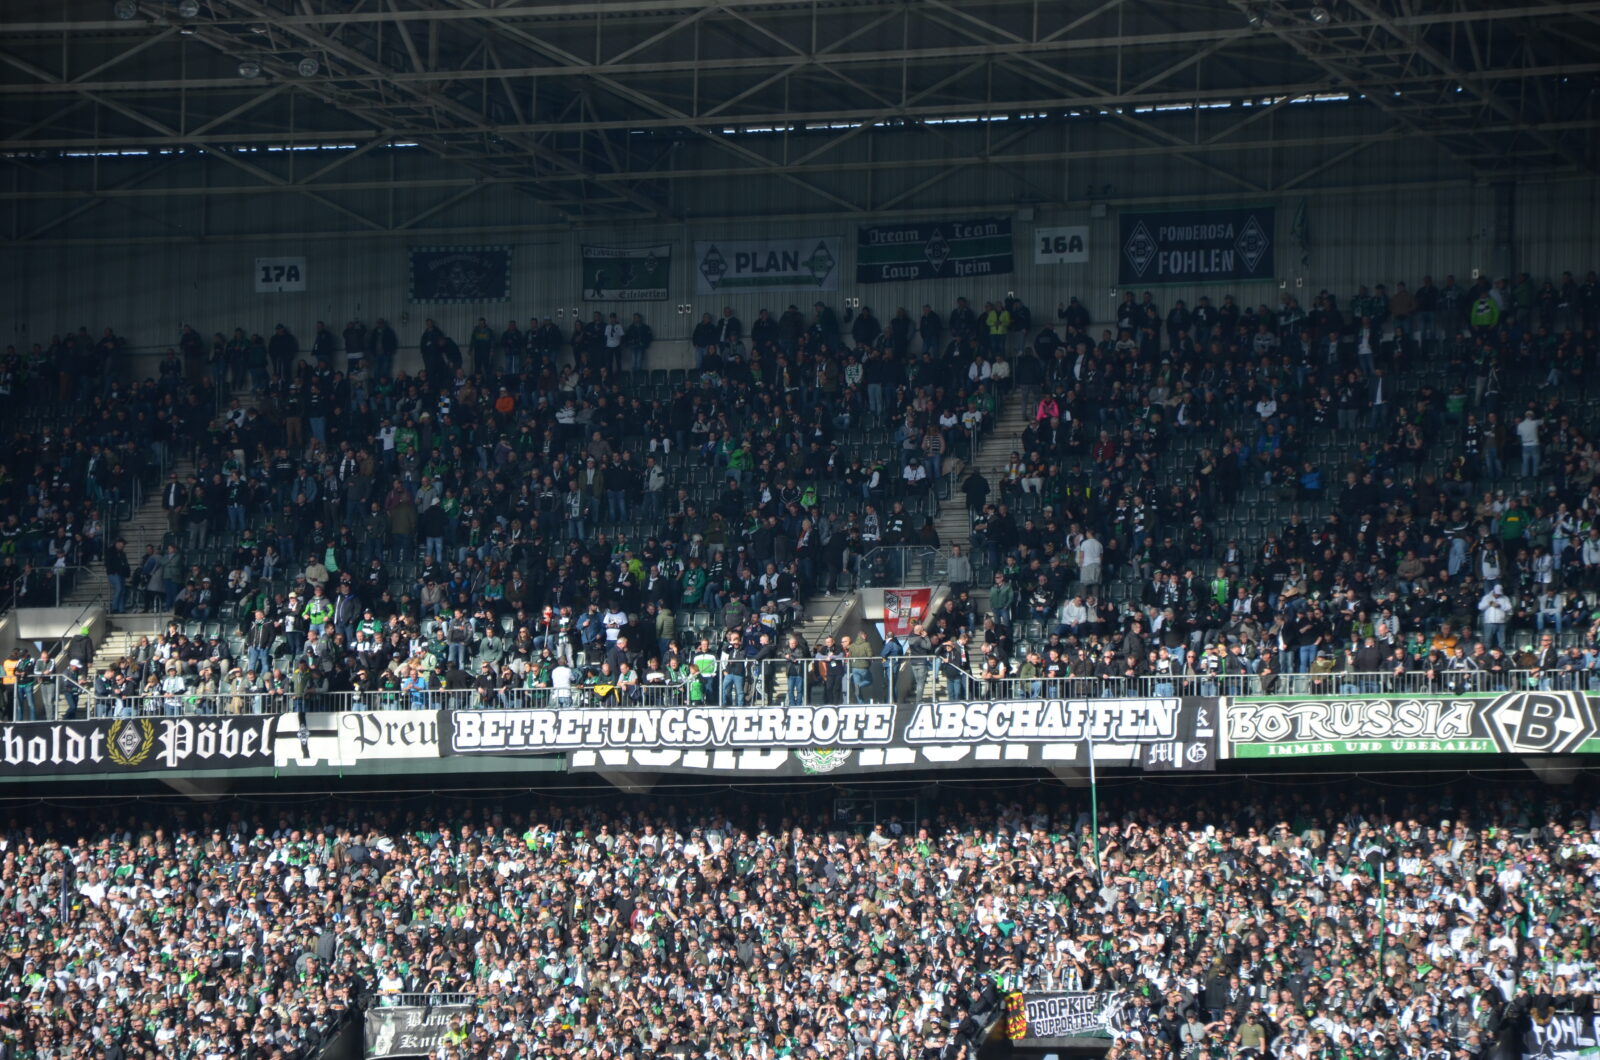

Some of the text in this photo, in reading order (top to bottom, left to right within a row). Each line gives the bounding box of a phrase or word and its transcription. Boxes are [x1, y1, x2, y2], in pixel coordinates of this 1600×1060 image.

[868, 223, 998, 243] Dream Team
[1159, 223, 1234, 242] PONDEROSA
[1041, 235, 1083, 254] 16A
[736, 250, 799, 273] PLAN
[882, 260, 991, 279] Laup heim
[1158, 249, 1235, 275] FOHLEN
[262, 265, 300, 283] 17A
[455, 700, 1178, 749] BETRETUNGSVERBOTE ABSCHAFFEN
[1228, 700, 1475, 741] BORUSSIA
[1514, 694, 1566, 749] B
[0, 716, 276, 767] boldt Pöbel
[1270, 738, 1488, 755] IMMER UND ÜBERALL!
[1034, 1013, 1099, 1037] SUPPORTERS
